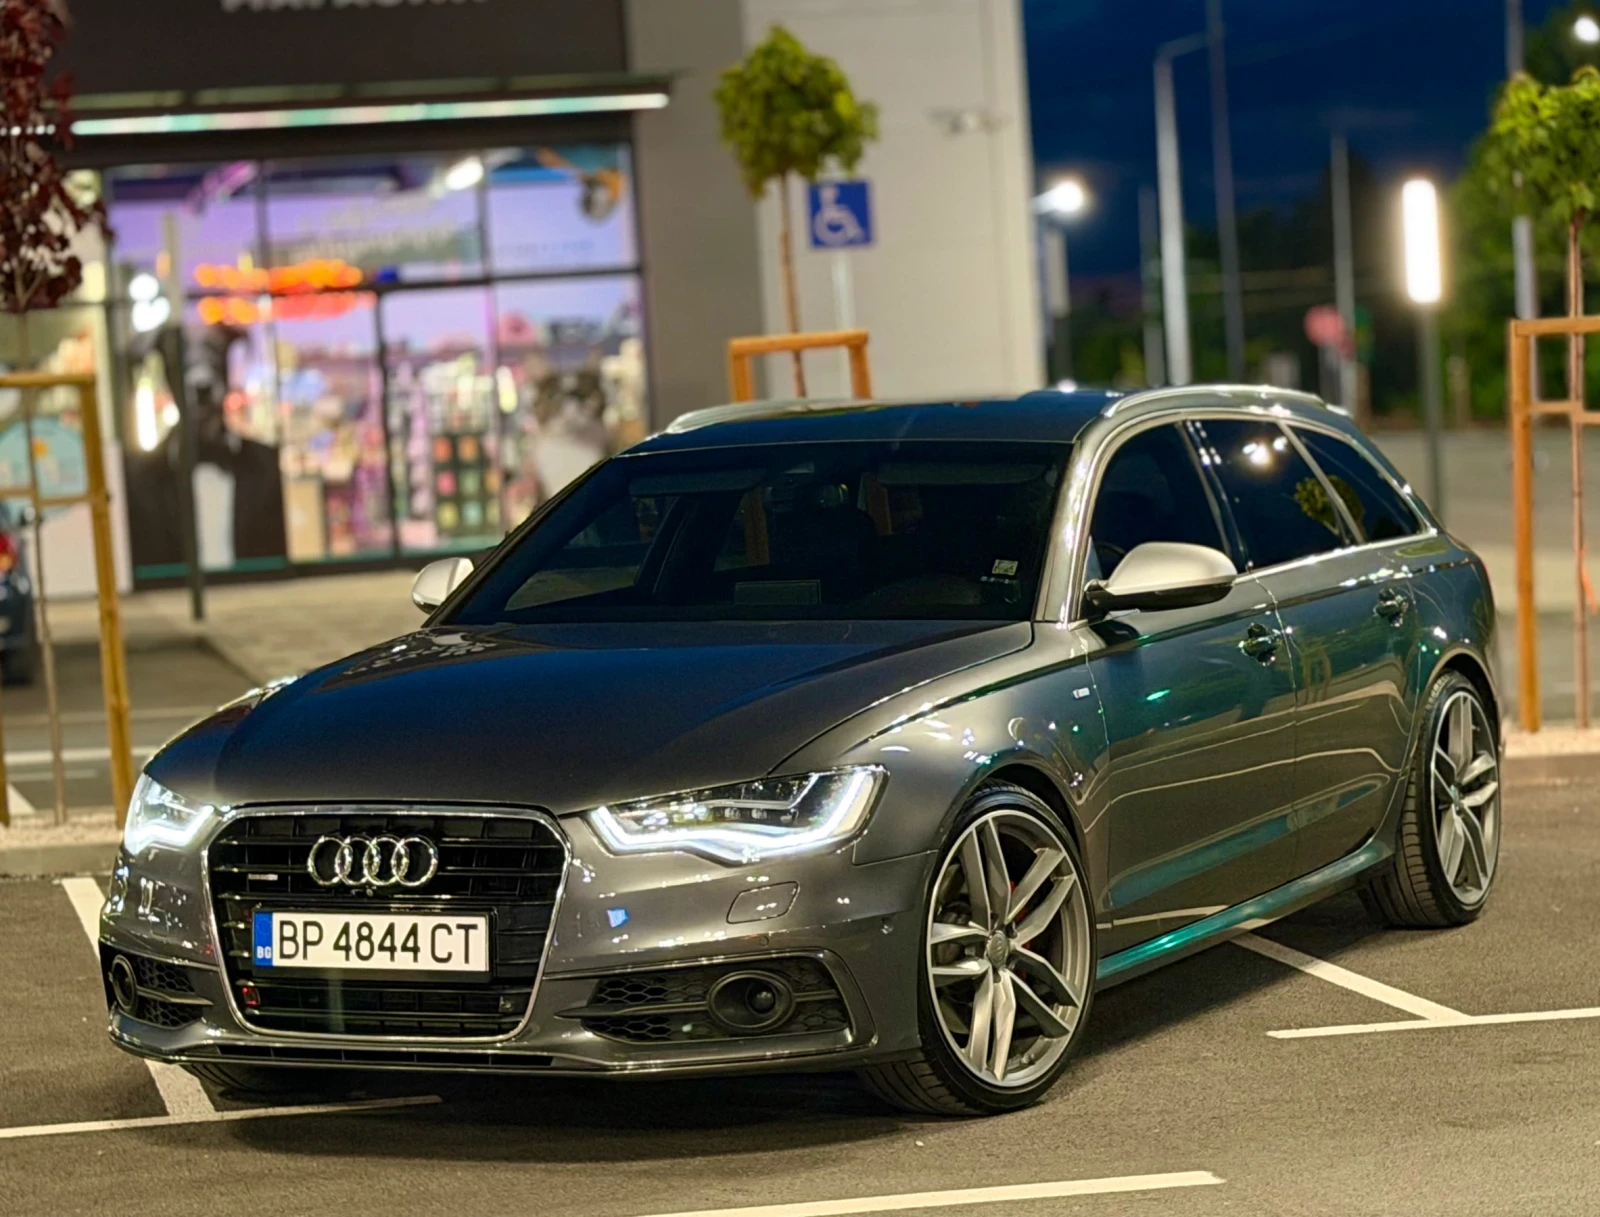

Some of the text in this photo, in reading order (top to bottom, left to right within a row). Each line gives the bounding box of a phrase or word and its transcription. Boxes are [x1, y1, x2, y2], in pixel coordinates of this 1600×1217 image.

[257, 946, 272, 959] BG
[279, 920, 478, 964] BP 4844 CT
